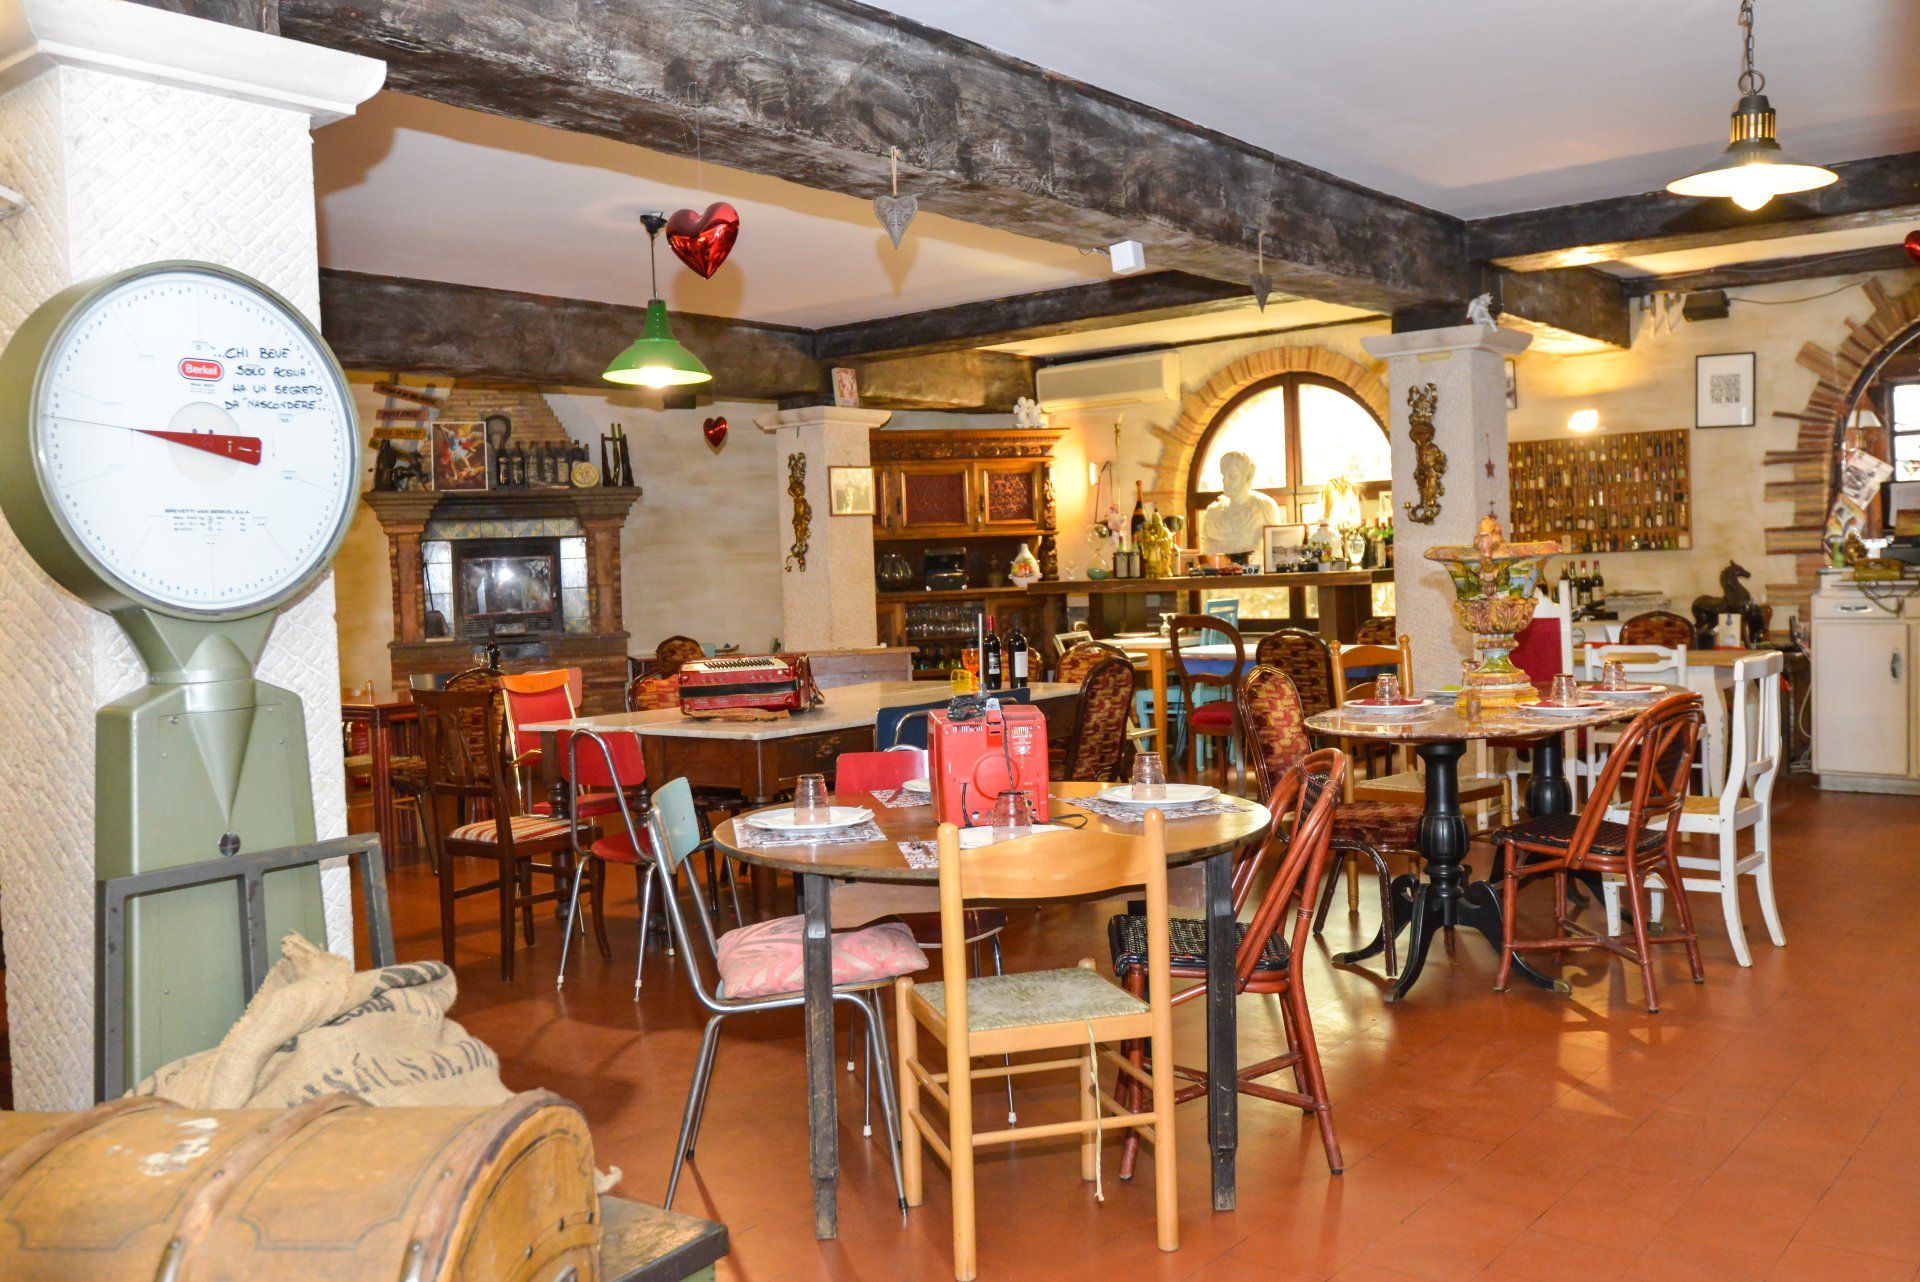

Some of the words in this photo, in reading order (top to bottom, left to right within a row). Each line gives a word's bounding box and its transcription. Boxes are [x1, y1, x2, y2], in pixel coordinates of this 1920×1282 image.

[259, 347, 290, 359] BEVE
[184, 363, 218, 376] Berkel
[236, 365, 266, 376] SOLO
[273, 367, 306, 377] ACQUA
[232, 384, 246, 393] HA
[253, 384, 267, 393] UN
[275, 385, 323, 395] SEGRETO
